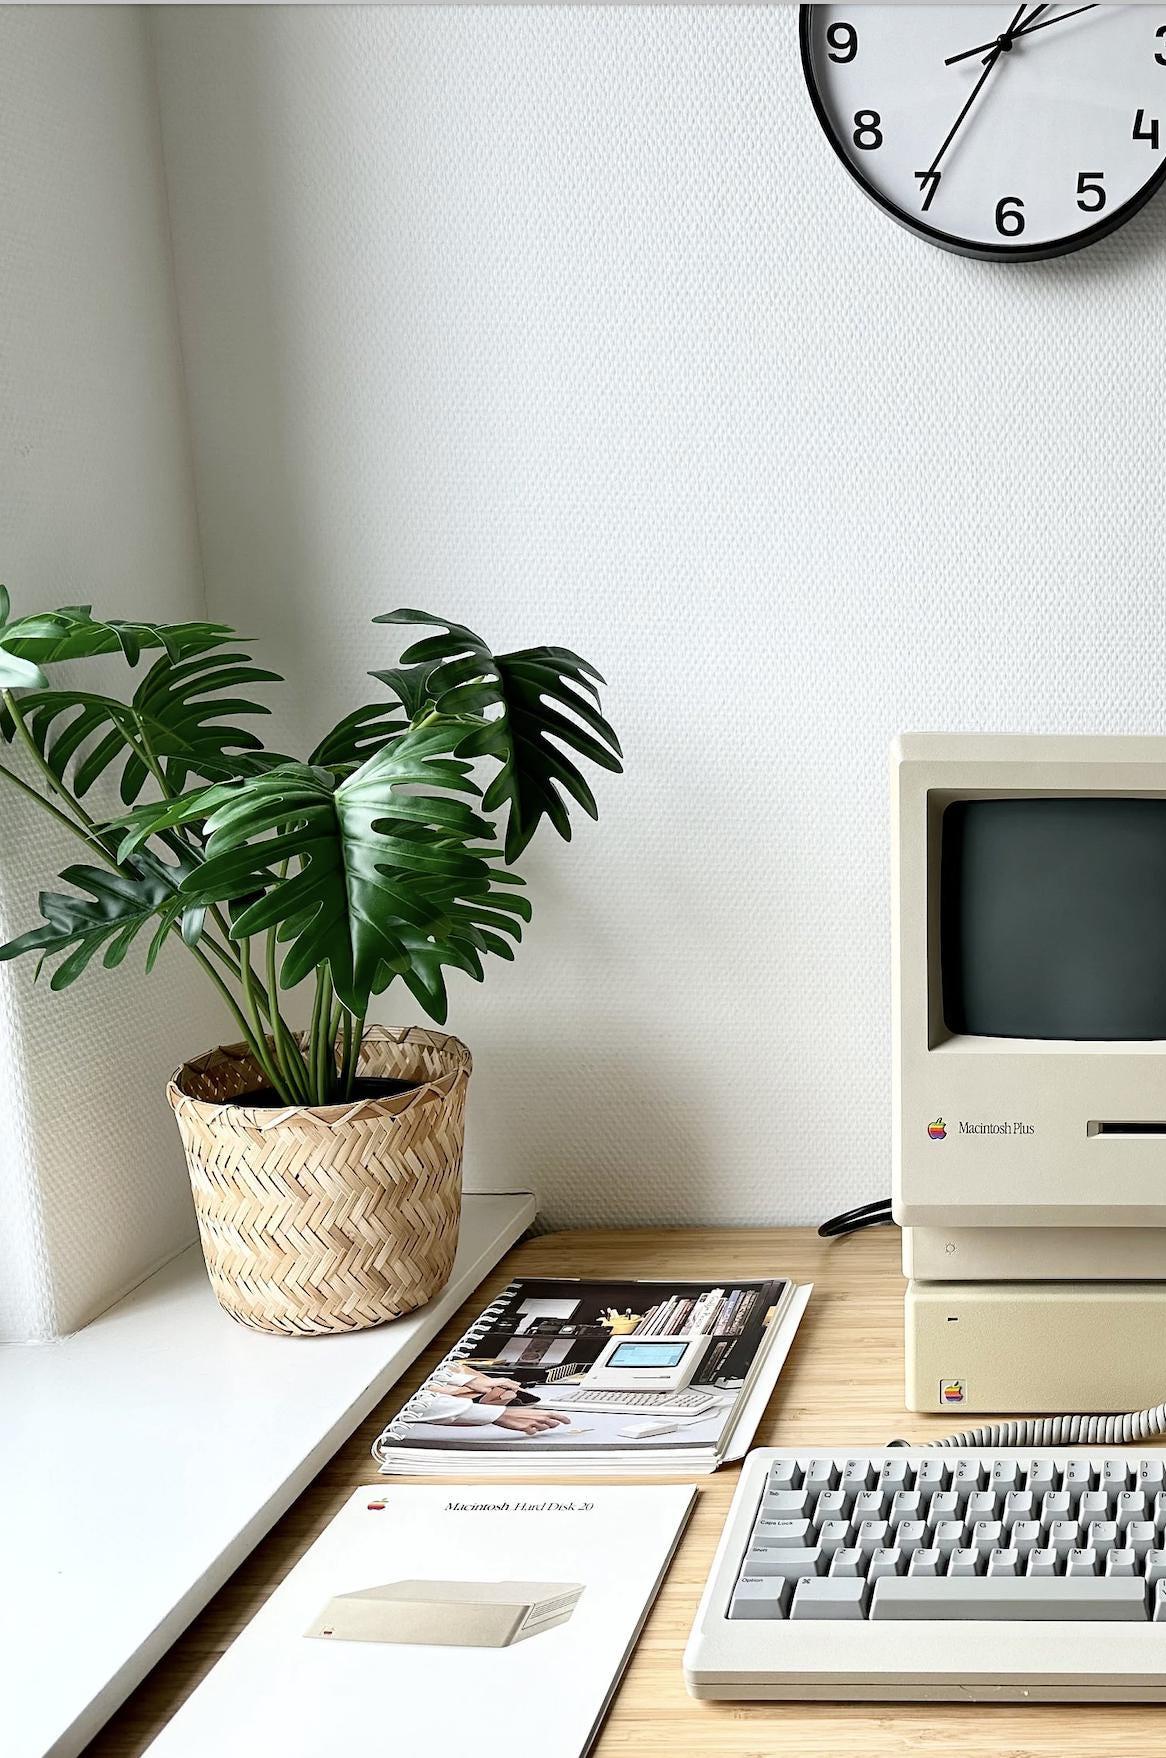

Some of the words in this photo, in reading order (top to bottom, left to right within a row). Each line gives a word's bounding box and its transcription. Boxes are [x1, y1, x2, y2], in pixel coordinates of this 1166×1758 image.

[827, 22, 858, 64] 9
[852, 110, 883, 150] 8
[1132, 109, 1160, 149] 4
[914, 171, 942, 211] 7
[1076, 172, 1107, 212] 5
[995, 196, 1026, 237] 6
[959, 1121, 1012, 1134] Macintosh
[1013, 1122, 1035, 1135] Plus
[445, 1502, 510, 1512] Macintosh
[514, 1502, 546, 1511] Hard
[547, 1502, 576, 1511] Disk
[578, 1502, 594, 1511] 20
